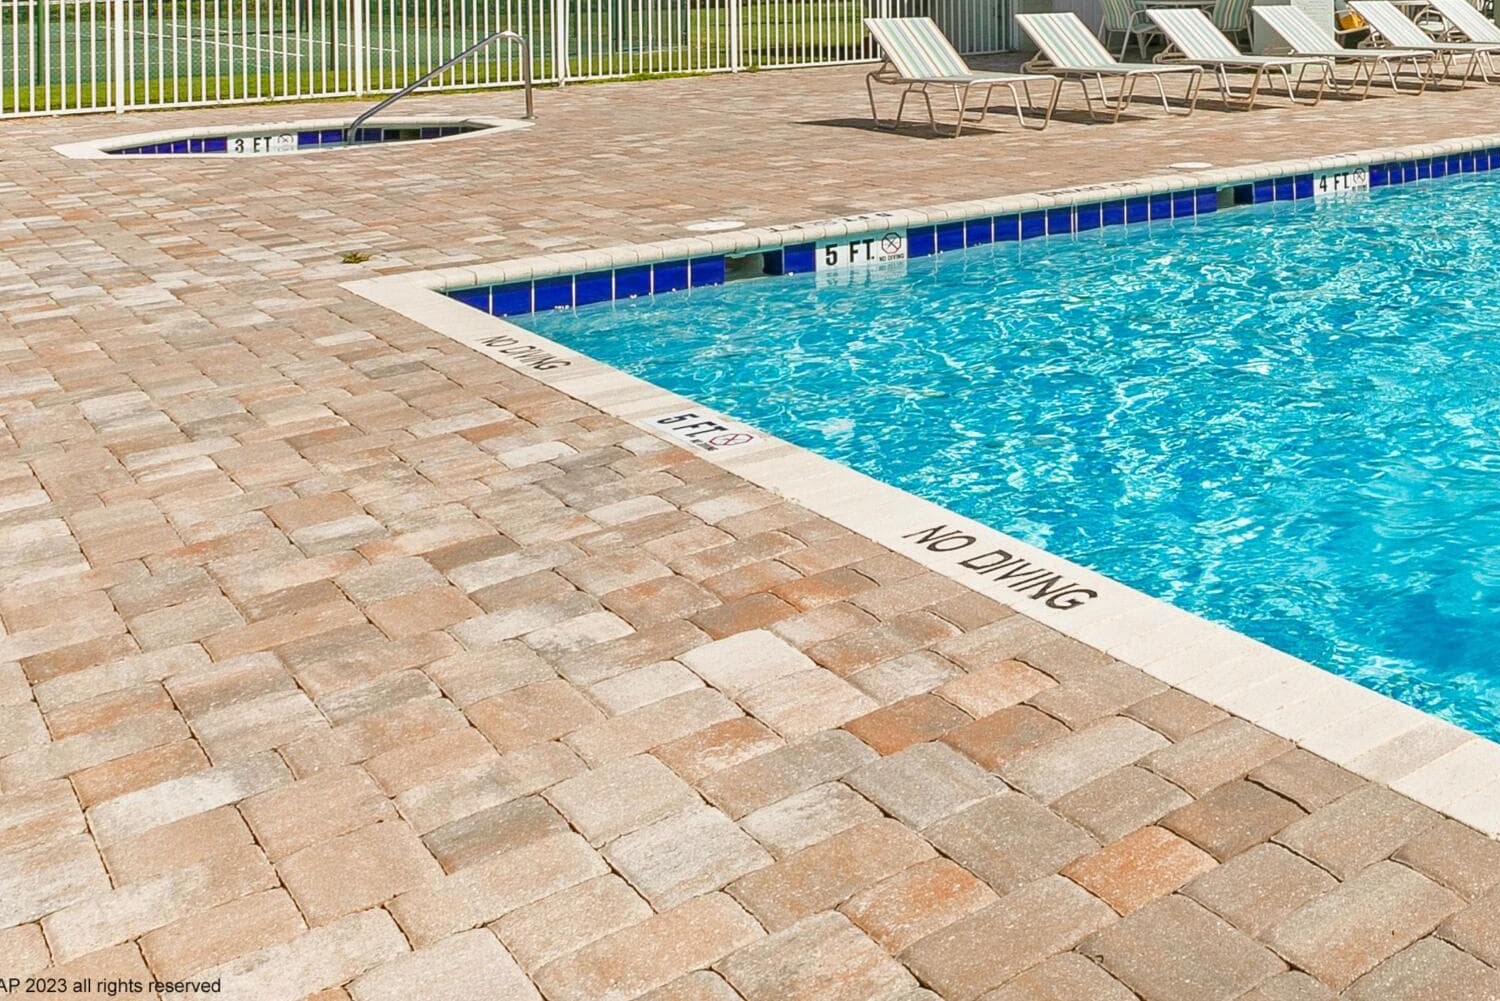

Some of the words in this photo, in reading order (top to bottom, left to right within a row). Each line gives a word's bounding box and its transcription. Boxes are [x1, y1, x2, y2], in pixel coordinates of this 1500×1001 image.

[1319, 174, 1328, 192] 4
[825, 243, 839, 266] 5
[657, 413, 700, 425] 5
[901, 524, 977, 552] NO
[957, 548, 1098, 611] DIVING
